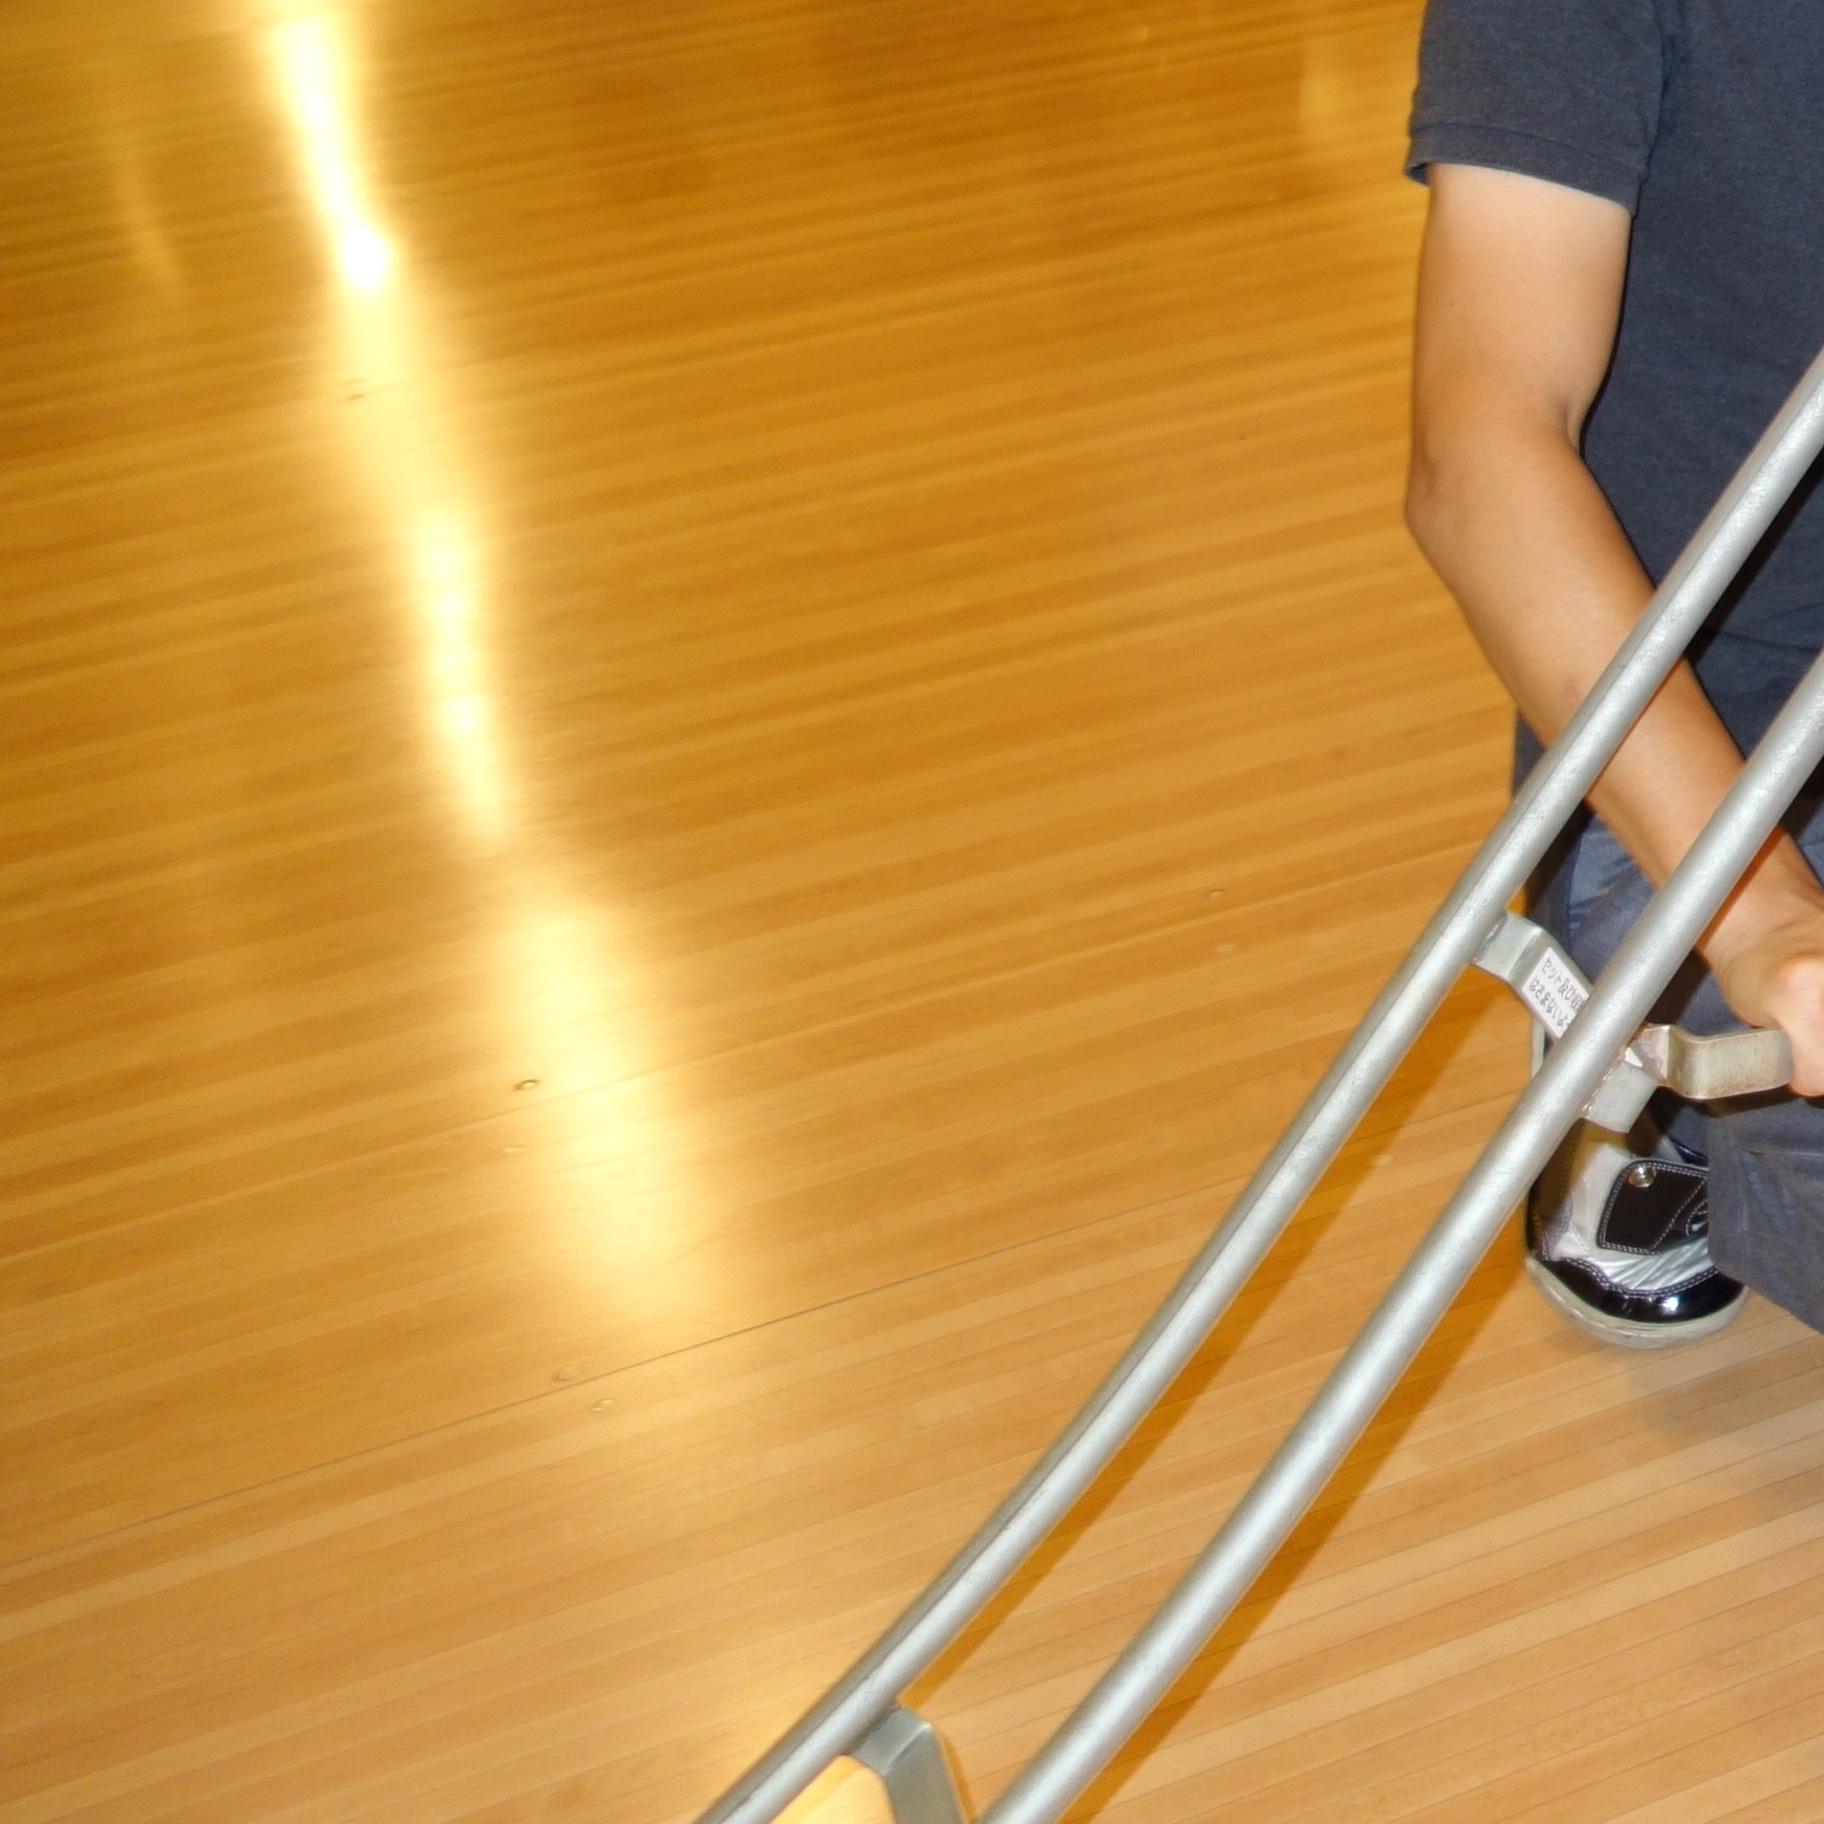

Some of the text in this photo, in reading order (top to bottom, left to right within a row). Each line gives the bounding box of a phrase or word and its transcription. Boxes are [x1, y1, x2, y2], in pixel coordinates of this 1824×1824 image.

[1529, 976, 1573, 1031] はさまないよ
